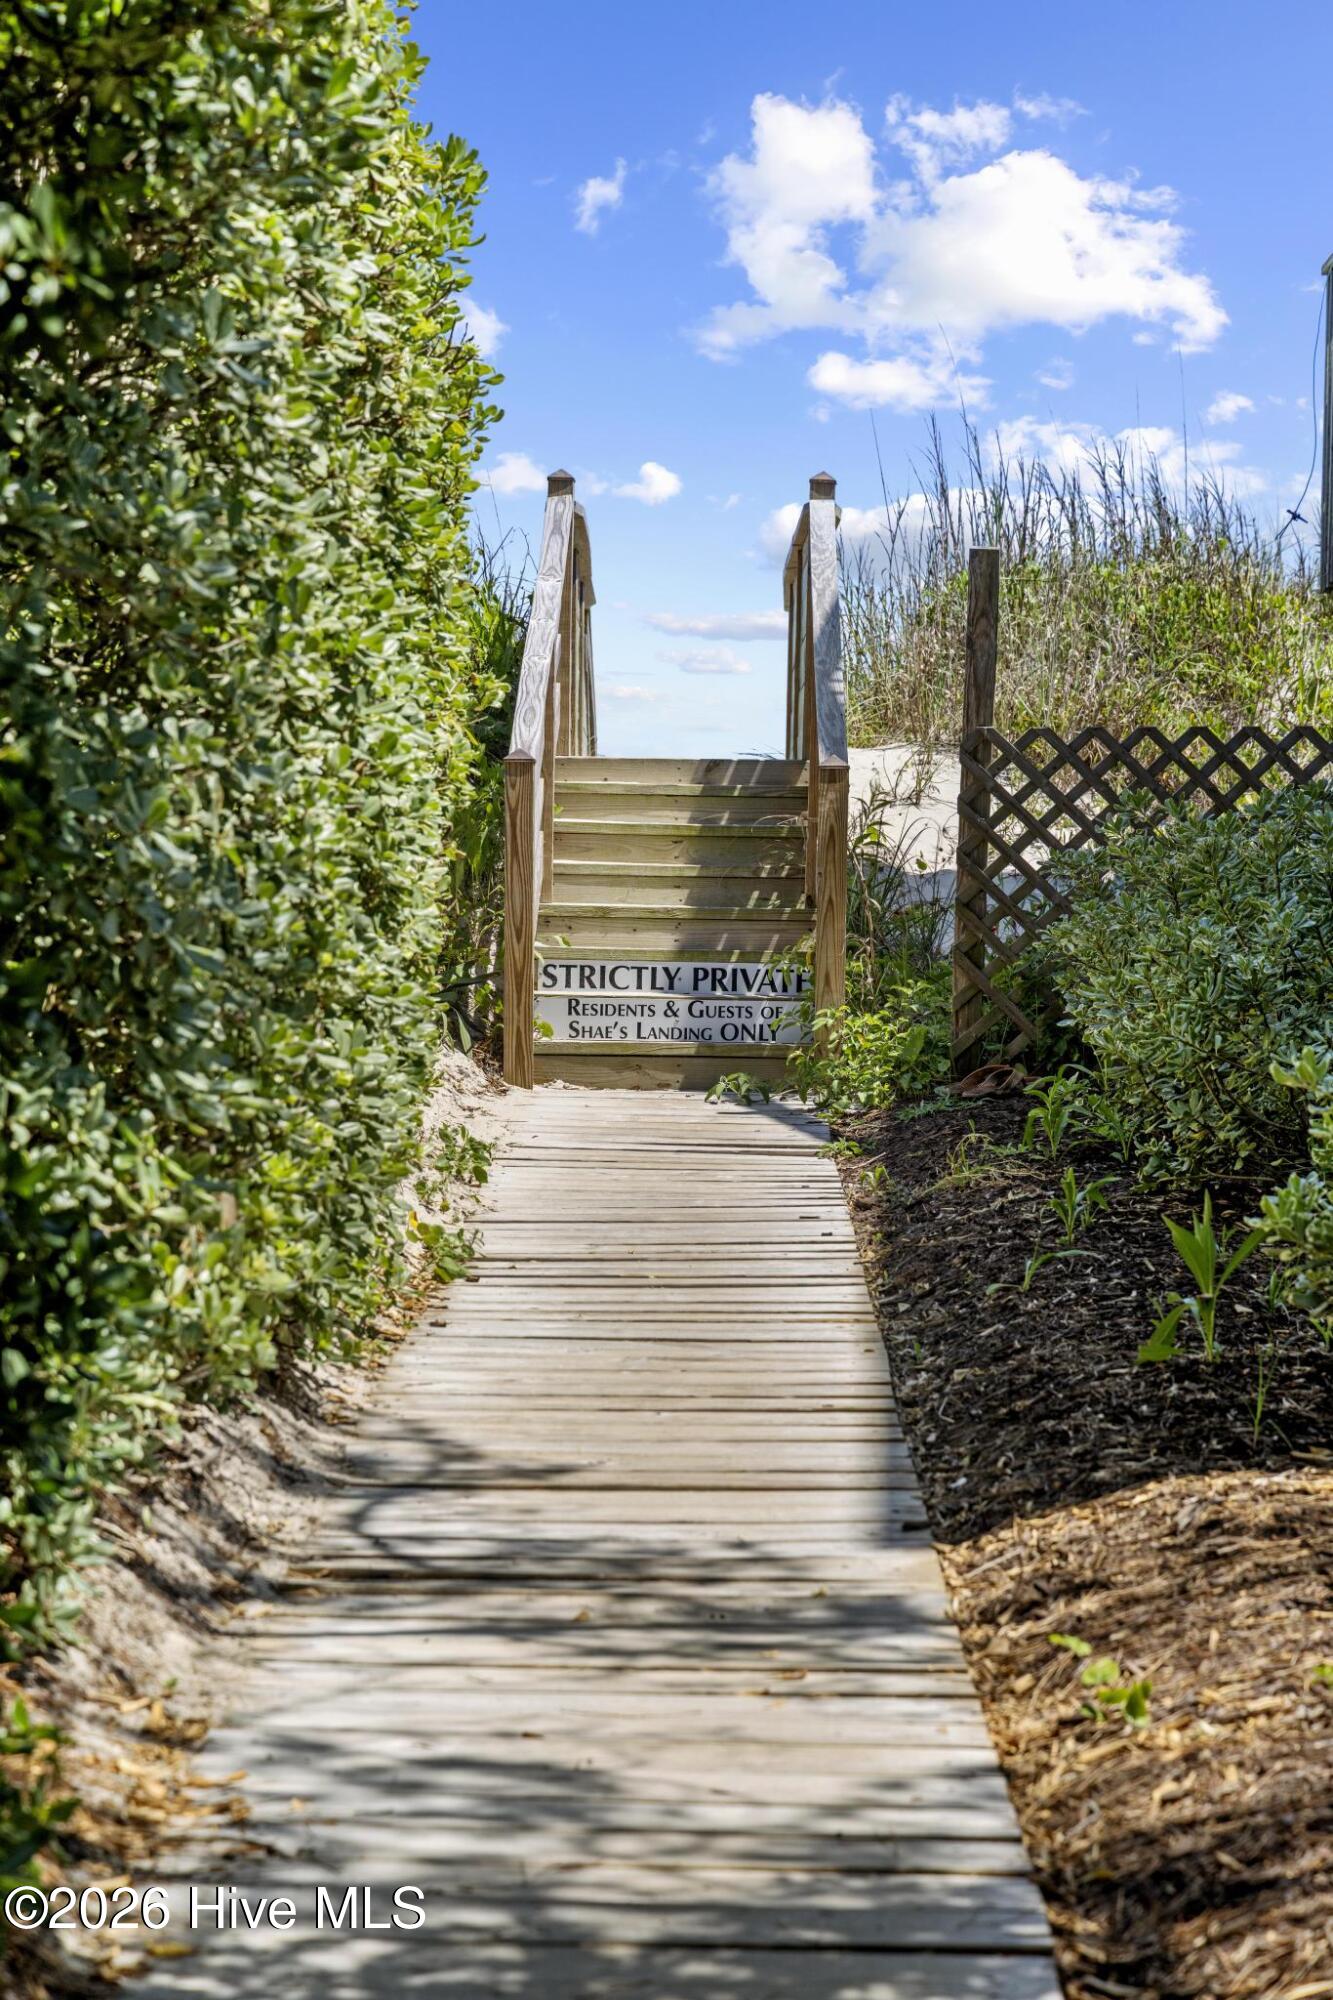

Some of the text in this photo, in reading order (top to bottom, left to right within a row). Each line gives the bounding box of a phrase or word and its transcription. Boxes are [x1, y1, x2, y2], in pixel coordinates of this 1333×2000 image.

[542, 964, 681, 991] STRICTLY
[567, 998, 784, 1019] RESIDENTS & GUESTS OF
[568, 1020, 782, 1042] SHAE'S LANDING ONLY
